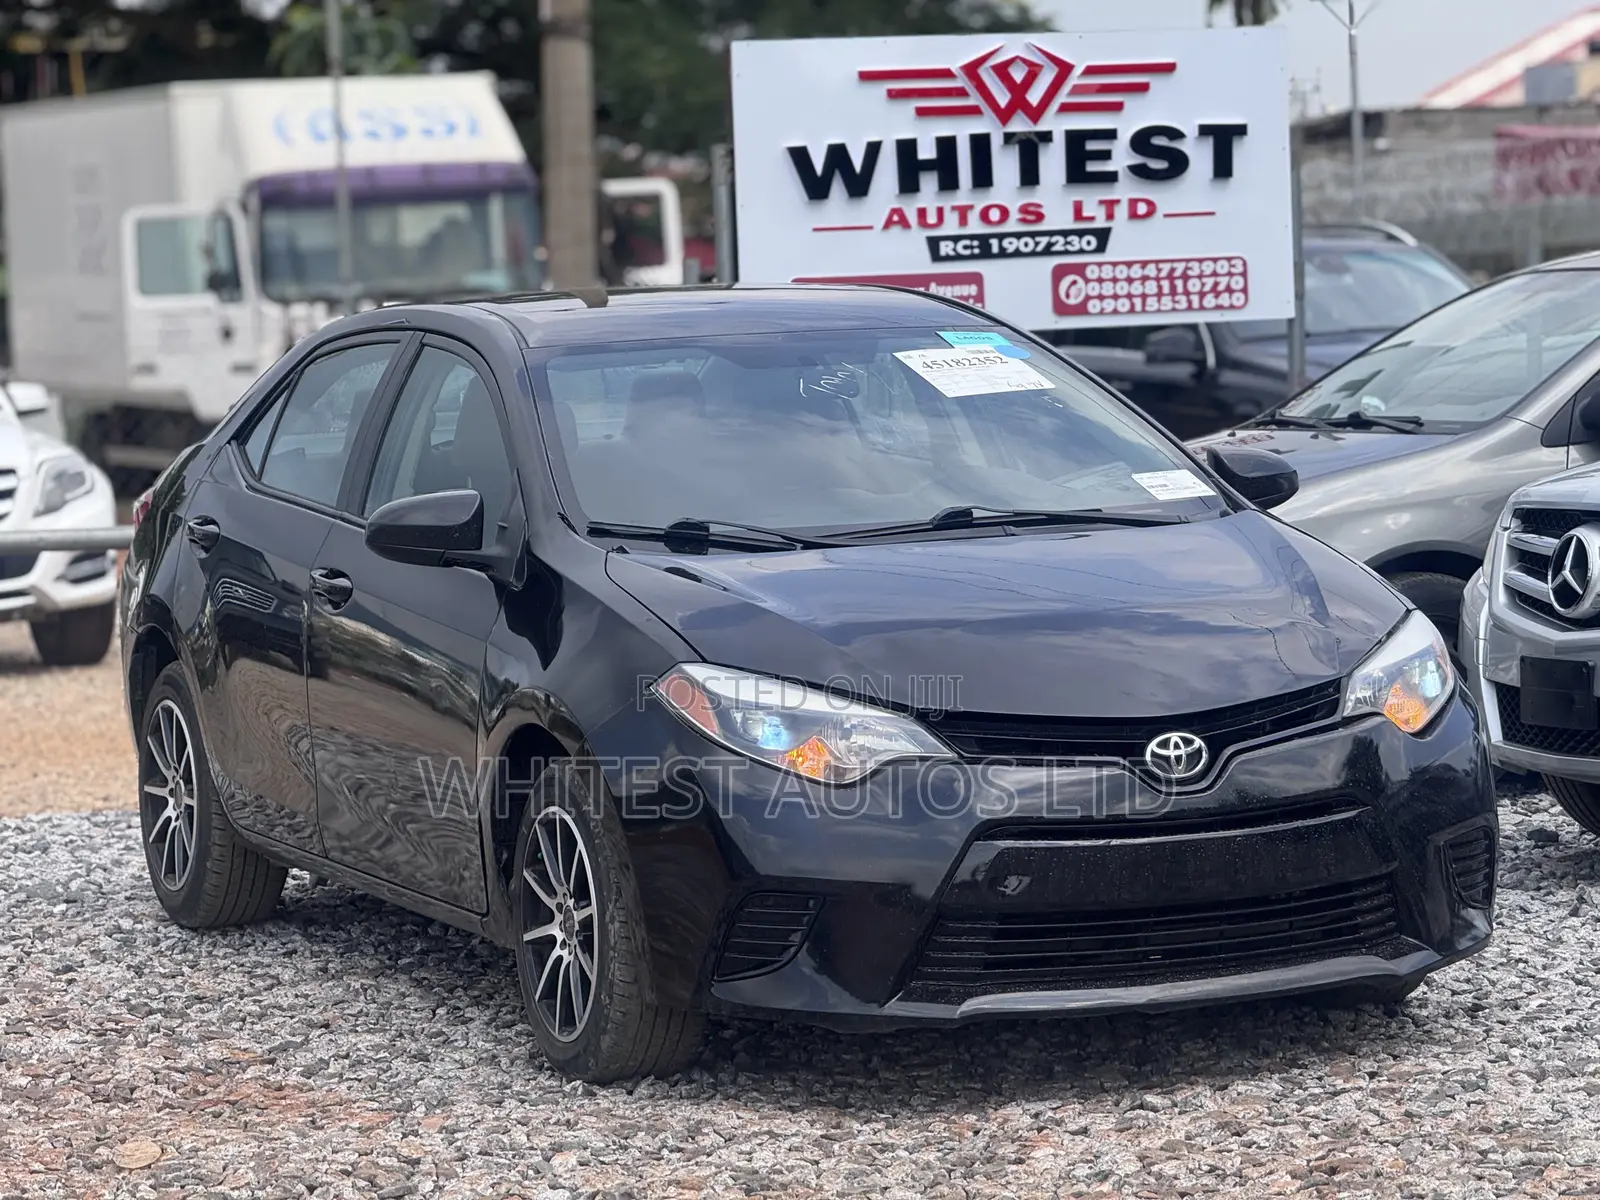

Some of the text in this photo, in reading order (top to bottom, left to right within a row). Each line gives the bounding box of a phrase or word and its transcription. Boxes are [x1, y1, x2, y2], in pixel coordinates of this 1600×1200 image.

[786, 123, 1248, 201] WHITEST
[881, 197, 1157, 231] AUTOS LTD
[938, 234, 1098, 257] RC: 1907230
[1084, 258, 1245, 280] 08064773903
[929, 281, 978, 297] Avenue
[1086, 275, 1245, 297] 08068110770
[1087, 291, 1246, 314] 09015531640
[921, 355, 1009, 370] 45182352
